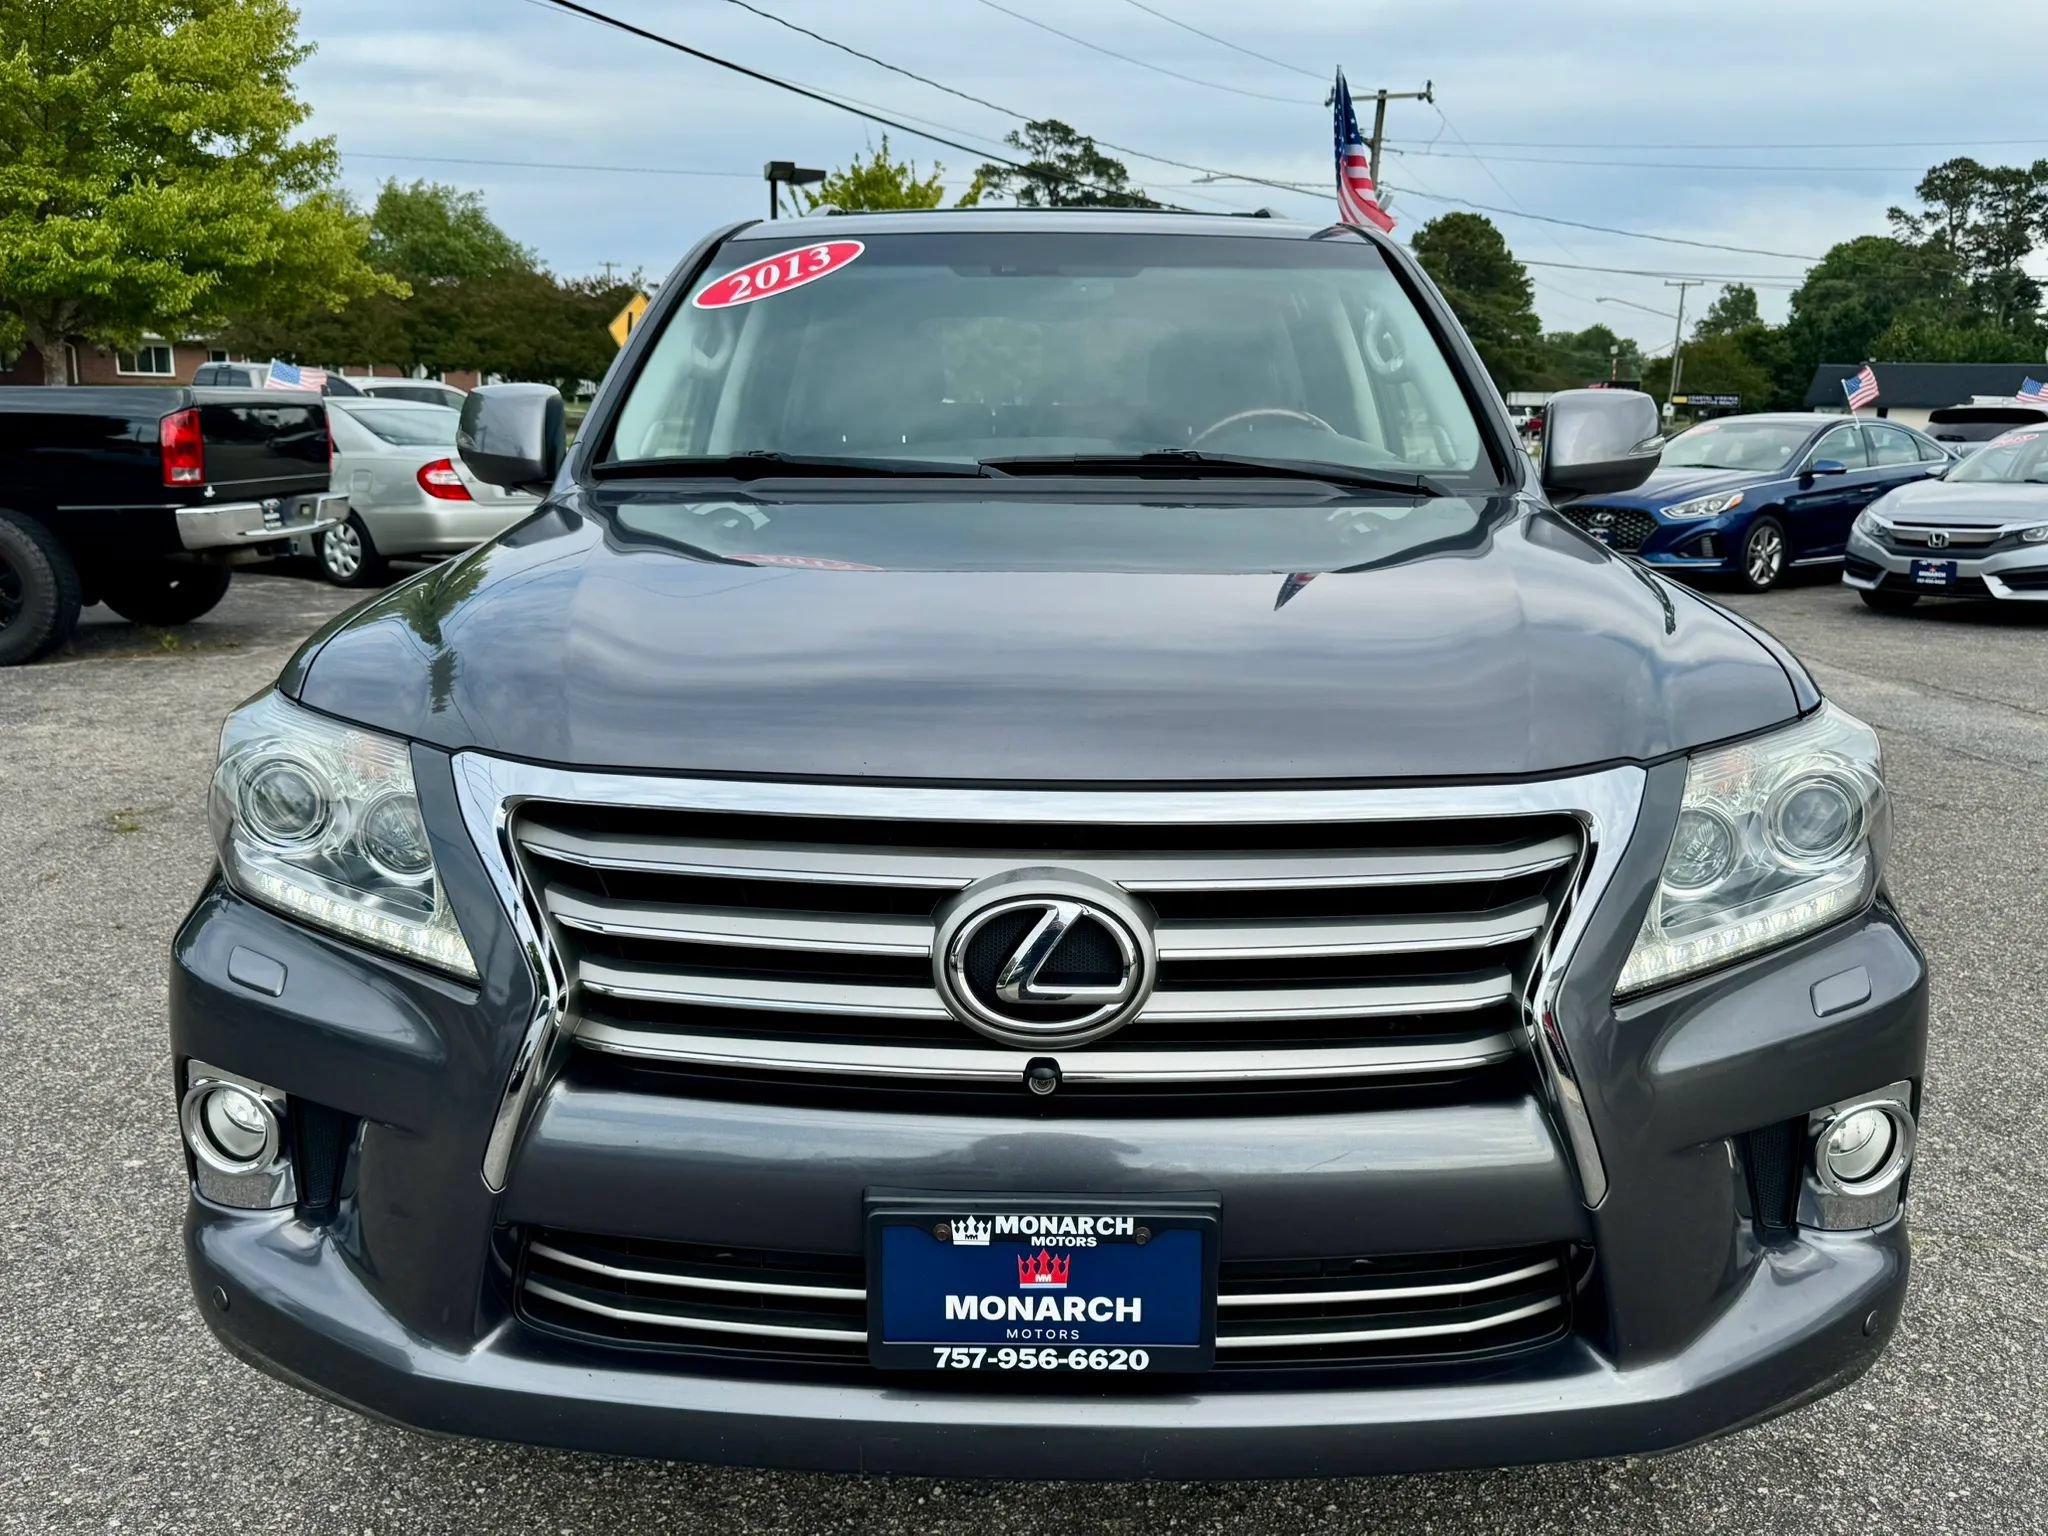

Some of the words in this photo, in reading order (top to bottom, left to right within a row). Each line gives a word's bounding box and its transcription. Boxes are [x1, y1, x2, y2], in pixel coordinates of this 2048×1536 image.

[728, 246, 831, 303] 2013
[995, 1215, 1134, 1236] MONARCH
[1031, 1236, 1098, 1247] MOTORS
[1035, 1273, 1052, 1283] MM
[945, 1295, 1142, 1323] MONARCH
[1006, 1328, 1080, 1340] MOTORS
[933, 1347, 1150, 1371] 757-956-6620
